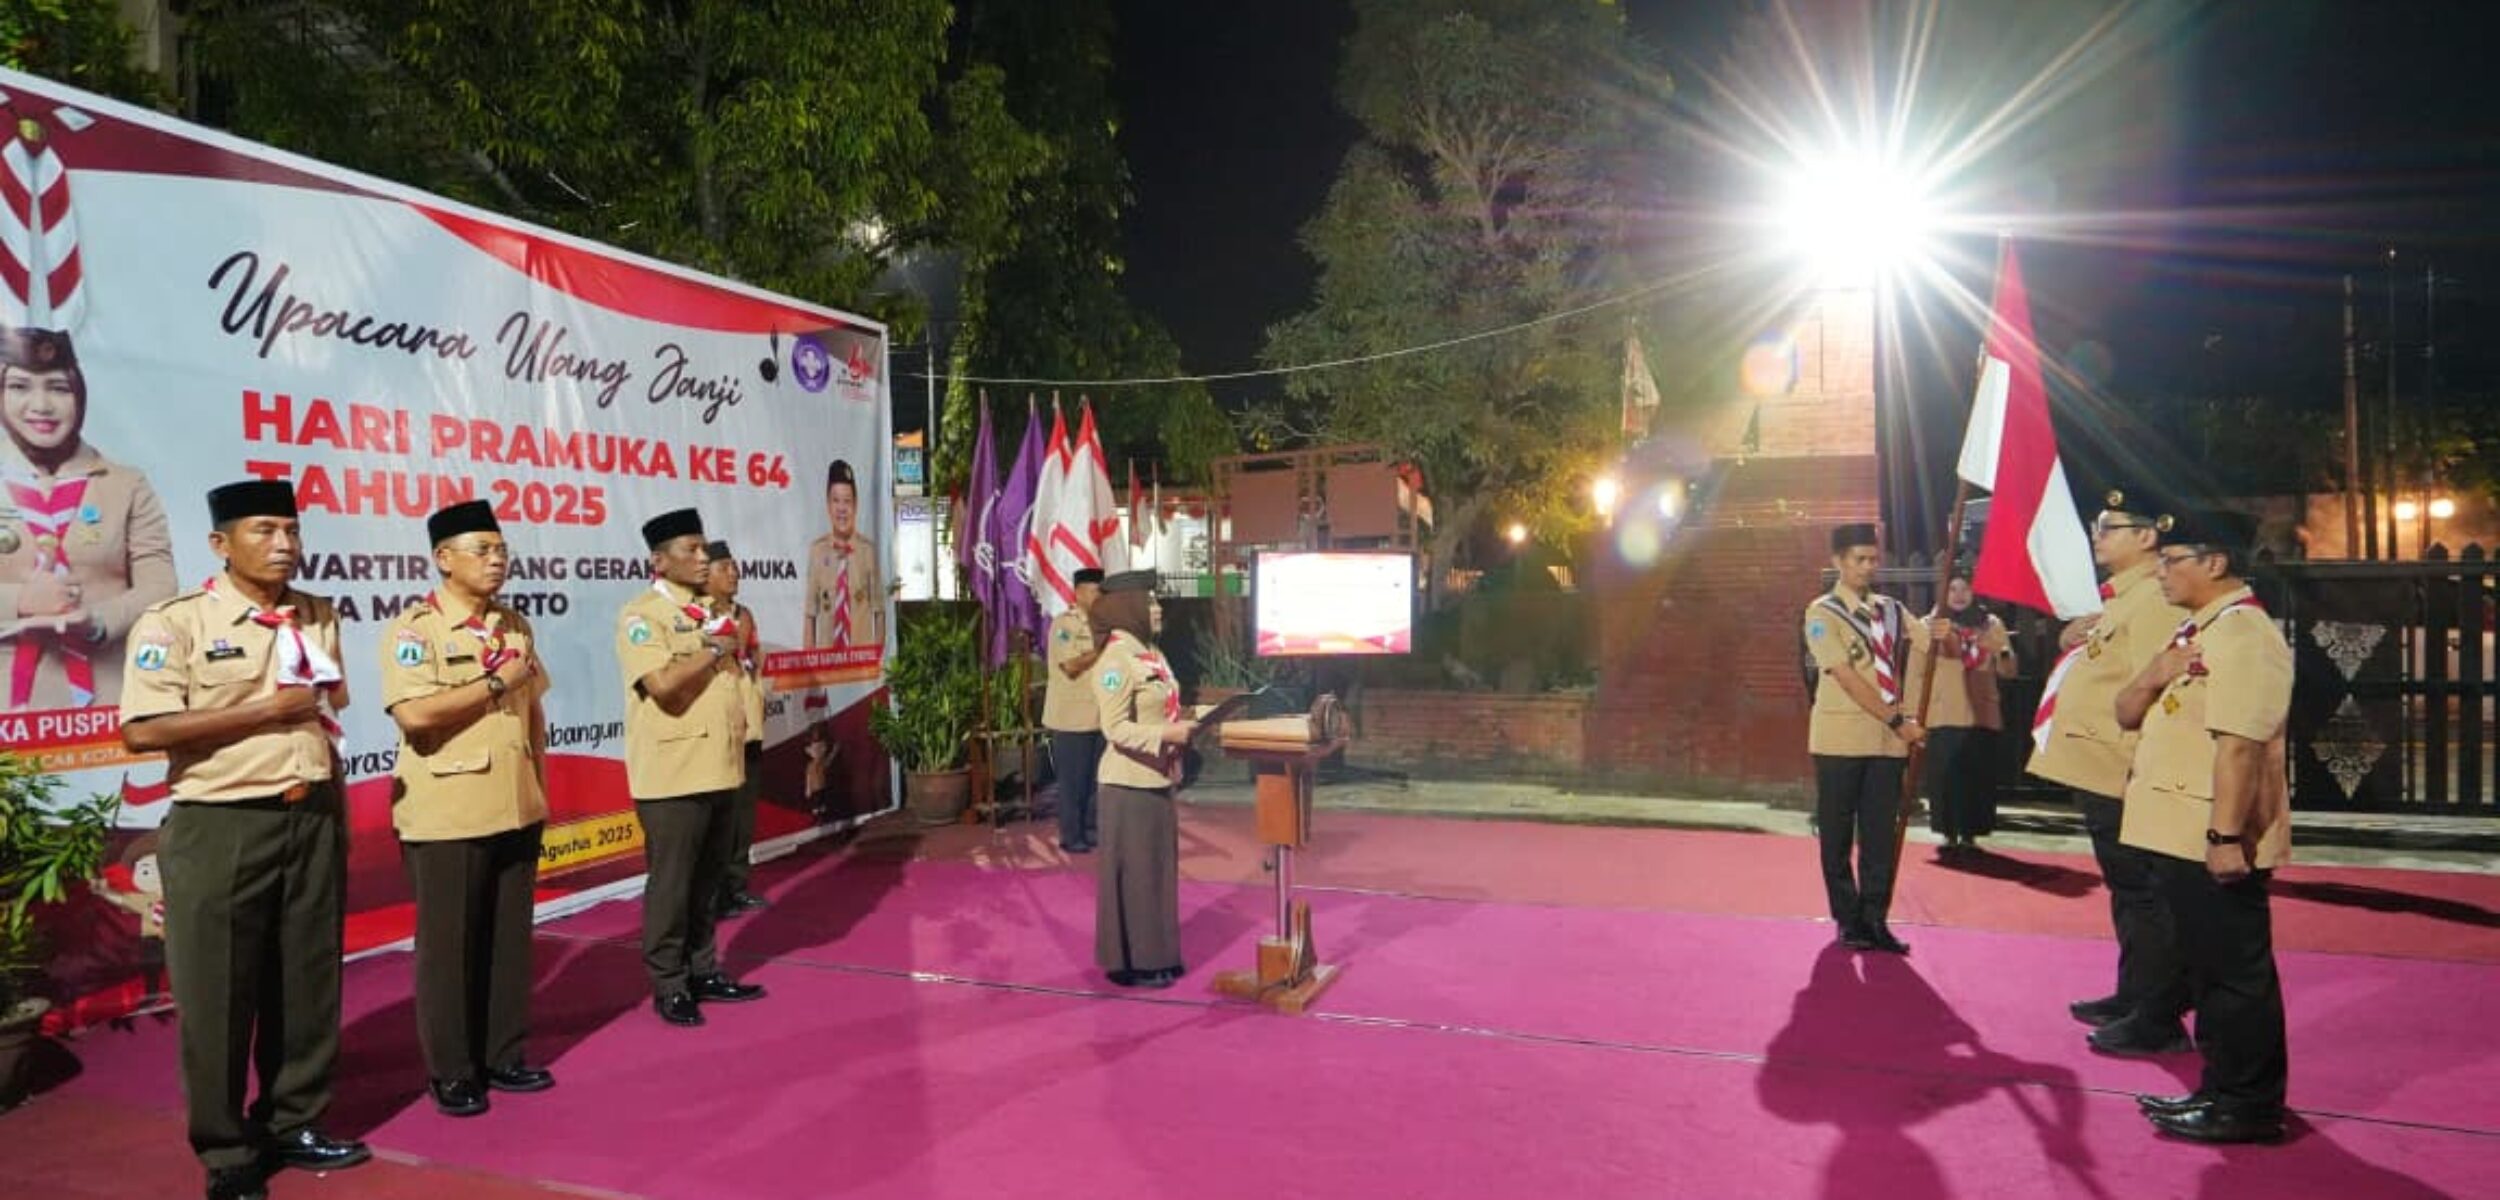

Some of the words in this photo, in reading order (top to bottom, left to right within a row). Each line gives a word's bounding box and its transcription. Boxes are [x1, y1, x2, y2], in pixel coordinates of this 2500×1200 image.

[208, 251, 477, 358] Upacara
[496, 312, 632, 408] Ulang
[648, 343, 742, 424] Janji
[242, 390, 411, 454] HARI
[430, 414, 678, 479] PRAMUKA
[688, 445, 737, 484] KE
[747, 453, 791, 489] 64
[245, 460, 474, 518] TAHUN
[491, 478, 607, 526] 2025
[287, 553, 430, 580] WARTIR
[506, 556, 567, 580] ANG
[597, 823, 633, 847] 2025
